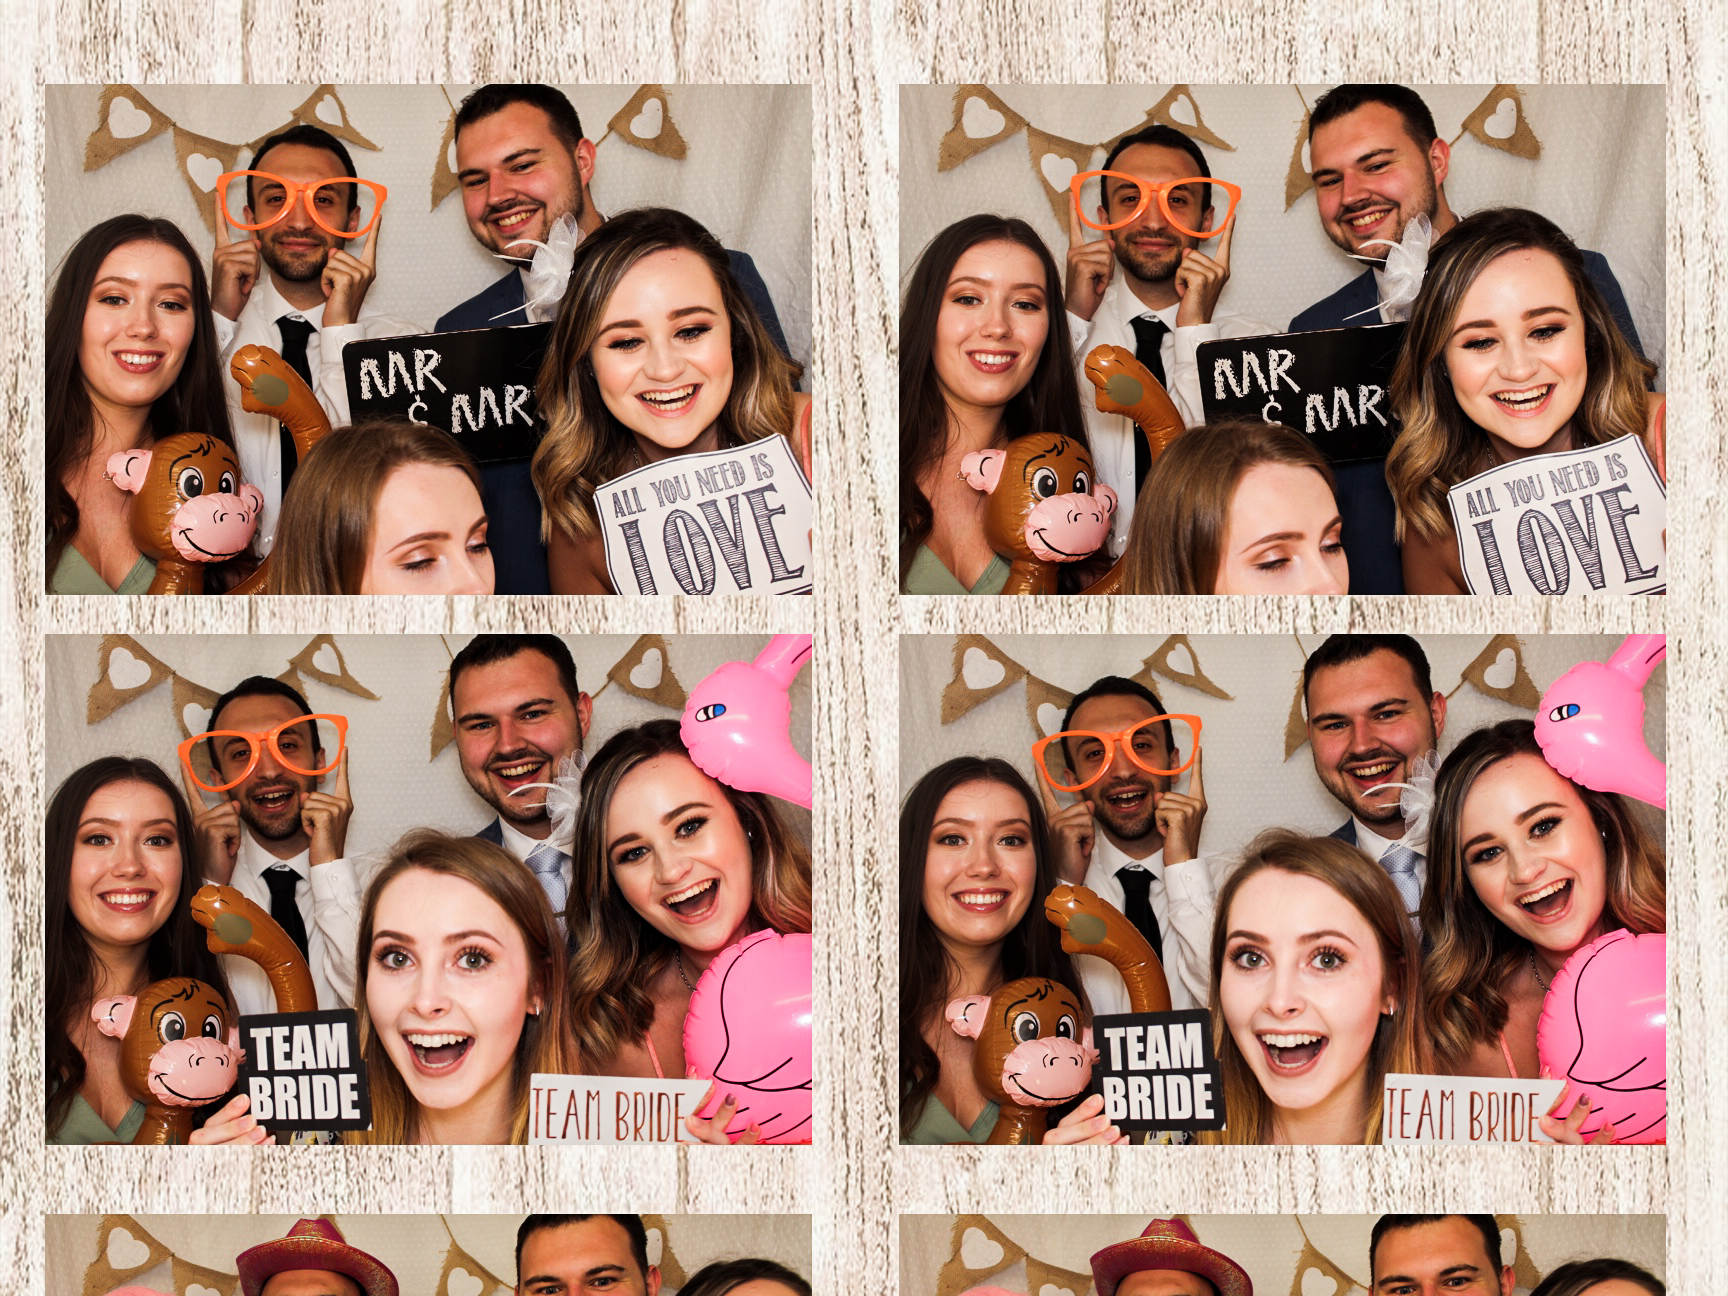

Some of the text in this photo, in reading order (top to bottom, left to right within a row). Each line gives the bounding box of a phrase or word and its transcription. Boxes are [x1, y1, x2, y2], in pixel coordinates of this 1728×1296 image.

[360, 349, 447, 400] MR
[1214, 349, 1301, 400] MR
[451, 384, 546, 434] MR
[1305, 384, 1400, 434] MR
[611, 453, 775, 518] ALL YOU NEED IS
[1465, 453, 1629, 518] ALL YOU NEED IS
[618, 482, 805, 595] LOVE
[1472, 482, 1659, 595] LOVE
[250, 1023, 350, 1071] TEAM
[1104, 1023, 1204, 1071] TEAM
[249, 1073, 361, 1121] BRIDE
[533, 1088, 686, 1143] TEAM BRIDE
[1103, 1073, 1215, 1121] BRIDE
[1387, 1088, 1540, 1143] TEAM BRIDE
